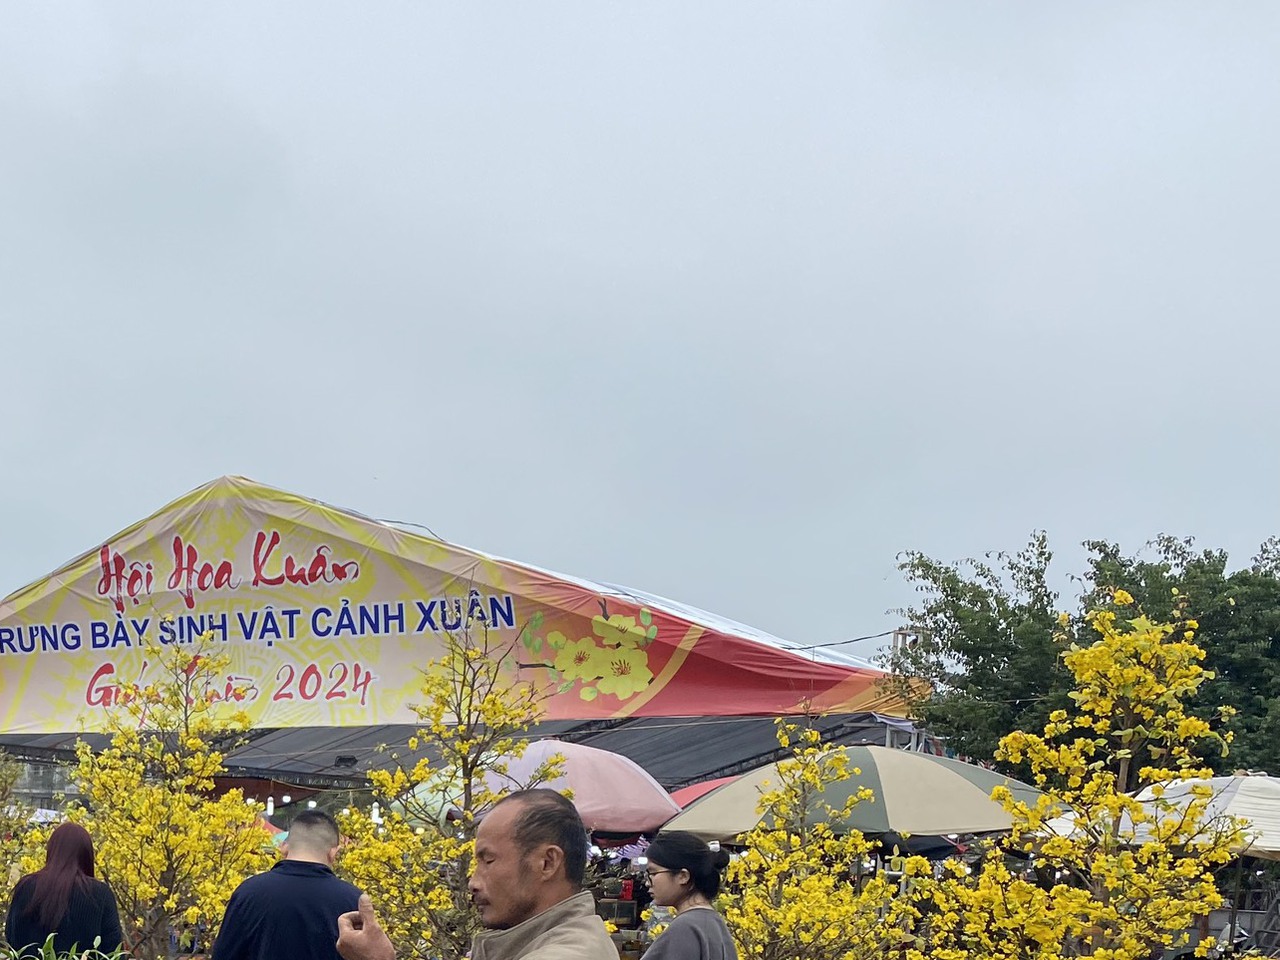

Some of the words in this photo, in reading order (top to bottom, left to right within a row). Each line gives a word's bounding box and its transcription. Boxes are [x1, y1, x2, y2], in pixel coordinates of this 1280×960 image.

[98, 544, 154, 614] Hội
[168, 535, 241, 610] Hoa
[252, 530, 360, 587] Xuân
[91, 613, 150, 649] BÀY
[159, 613, 228, 645] SINH
[237, 606, 301, 646] VẬT
[311, 599, 405, 637] CẢNH
[416, 589, 514, 632] XUÂN
[273, 662, 378, 706] 2024
